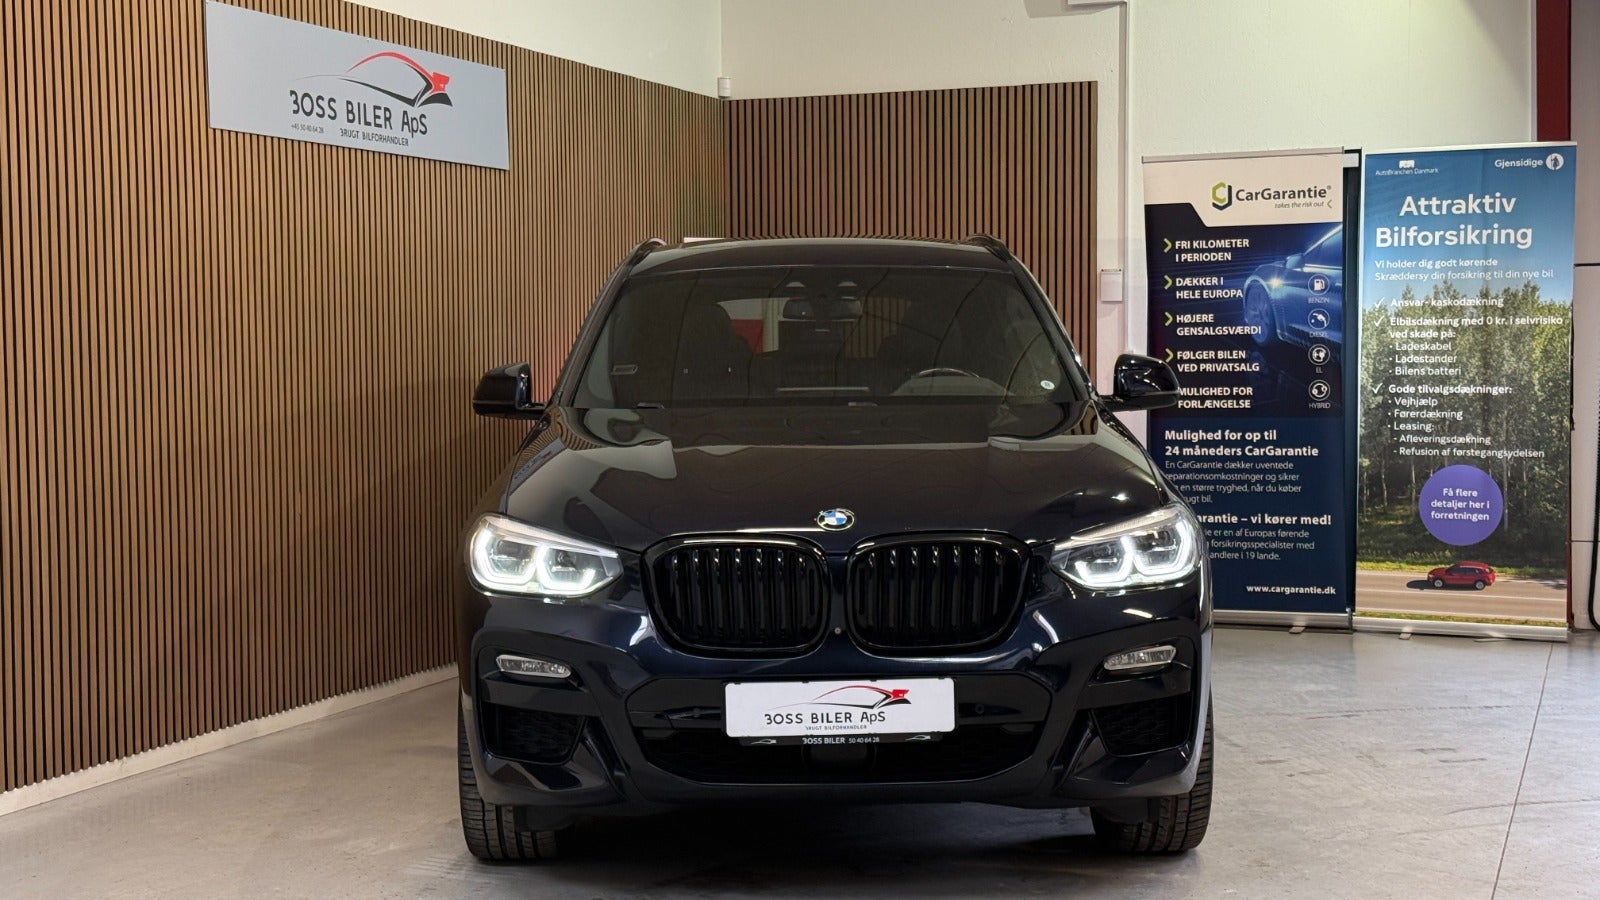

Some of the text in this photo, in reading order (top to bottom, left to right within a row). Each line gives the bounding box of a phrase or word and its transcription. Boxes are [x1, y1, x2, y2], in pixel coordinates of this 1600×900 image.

[346, 100, 392, 130] BILER
[401, 110, 428, 138] ApS
[362, 132, 409, 146] BILFORHANDLER
[1494, 158, 1543, 168] Gjensidige
[1399, 192, 1516, 216] Attraktiv
[1376, 224, 1532, 249] Bilforsikring
[1176, 239, 1250, 250] FRI KILOMETER
[1182, 252, 1232, 262] PERIODEN
[1375, 258, 1498, 270] Vi holder dig godt kørende
[1375, 269, 1554, 282] Skræddersy din forsikring til din nye bil
[1176, 278, 1218, 286] DÆKKER
[1176, 290, 1244, 299] HELE EUROPA
[1431, 298, 1504, 308] kaskodækning
[1176, 314, 1214, 323] HØJERE
[1390, 317, 1460, 327] Elbilsdækning
[1462, 317, 1484, 326] med
[1486, 317, 1492, 325] 0
[1495, 316, 1508, 326] kr.
[1515, 316, 1563, 326] selvrisiko
[1176, 326, 1262, 336] GENSALGSVÆRDI
[1390, 330, 1456, 340] ved skade på:
[1396, 342, 1452, 350] Ladeskabel
[1177, 350, 1246, 360] FØLGER BILEN
[1396, 354, 1458, 364] Ladestander
[1178, 363, 1260, 372] VED PRIVATSALG
[1395, 366, 1462, 376] Bilens batteri
[1179, 387, 1253, 396] MULIGHED FOR
[1388, 384, 1512, 395] Gode tilvalgsdækninger:
[1178, 400, 1251, 408] FORLÆNGELSE
[1394, 396, 1438, 406] Vejhjælp
[1394, 410, 1463, 420] Førerdækning
[1394, 422, 1434, 432] Leasing:
[1165, 430, 1276, 442] Mulighed for op til
[1400, 435, 1491, 445] Afleveringsdækning
[1165, 446, 1319, 456] 24 måneders CarGarantie
[1400, 447, 1545, 460] Refusion af førstegangsydelsen
[1166, 460, 1294, 470] En CarGarantie dækker uventede
[1265, 474, 1277, 482] og
[1278, 472, 1300, 480] sikrer
[1216, 484, 1249, 494] tryghed,
[1250, 484, 1264, 492] når
[1266, 484, 1276, 492] du
[1278, 484, 1302, 492] køber
[1442, 488, 1478, 496] Få flere
[1202, 494, 1213, 503] bil.
[1431, 499, 1467, 510] detaljer
[1469, 500, 1484, 508] her
[1250, 514, 1262, 524] vi
[1264, 514, 1296, 524] kører
[1300, 514, 1332, 526] med!
[1431, 511, 1490, 522] forretningen
[1244, 529, 1276, 538] Europas
[1278, 529, 1310, 538] førende
[1211, 540, 1294, 550] forsikringsspecialister
[1296, 541, 1315, 550] med
[1256, 552, 1281, 560] lande.
[1246, 584, 1336, 595] www.cargarantie.dk
[811, 712, 852, 724] BILER
[860, 711, 886, 724] ApS
